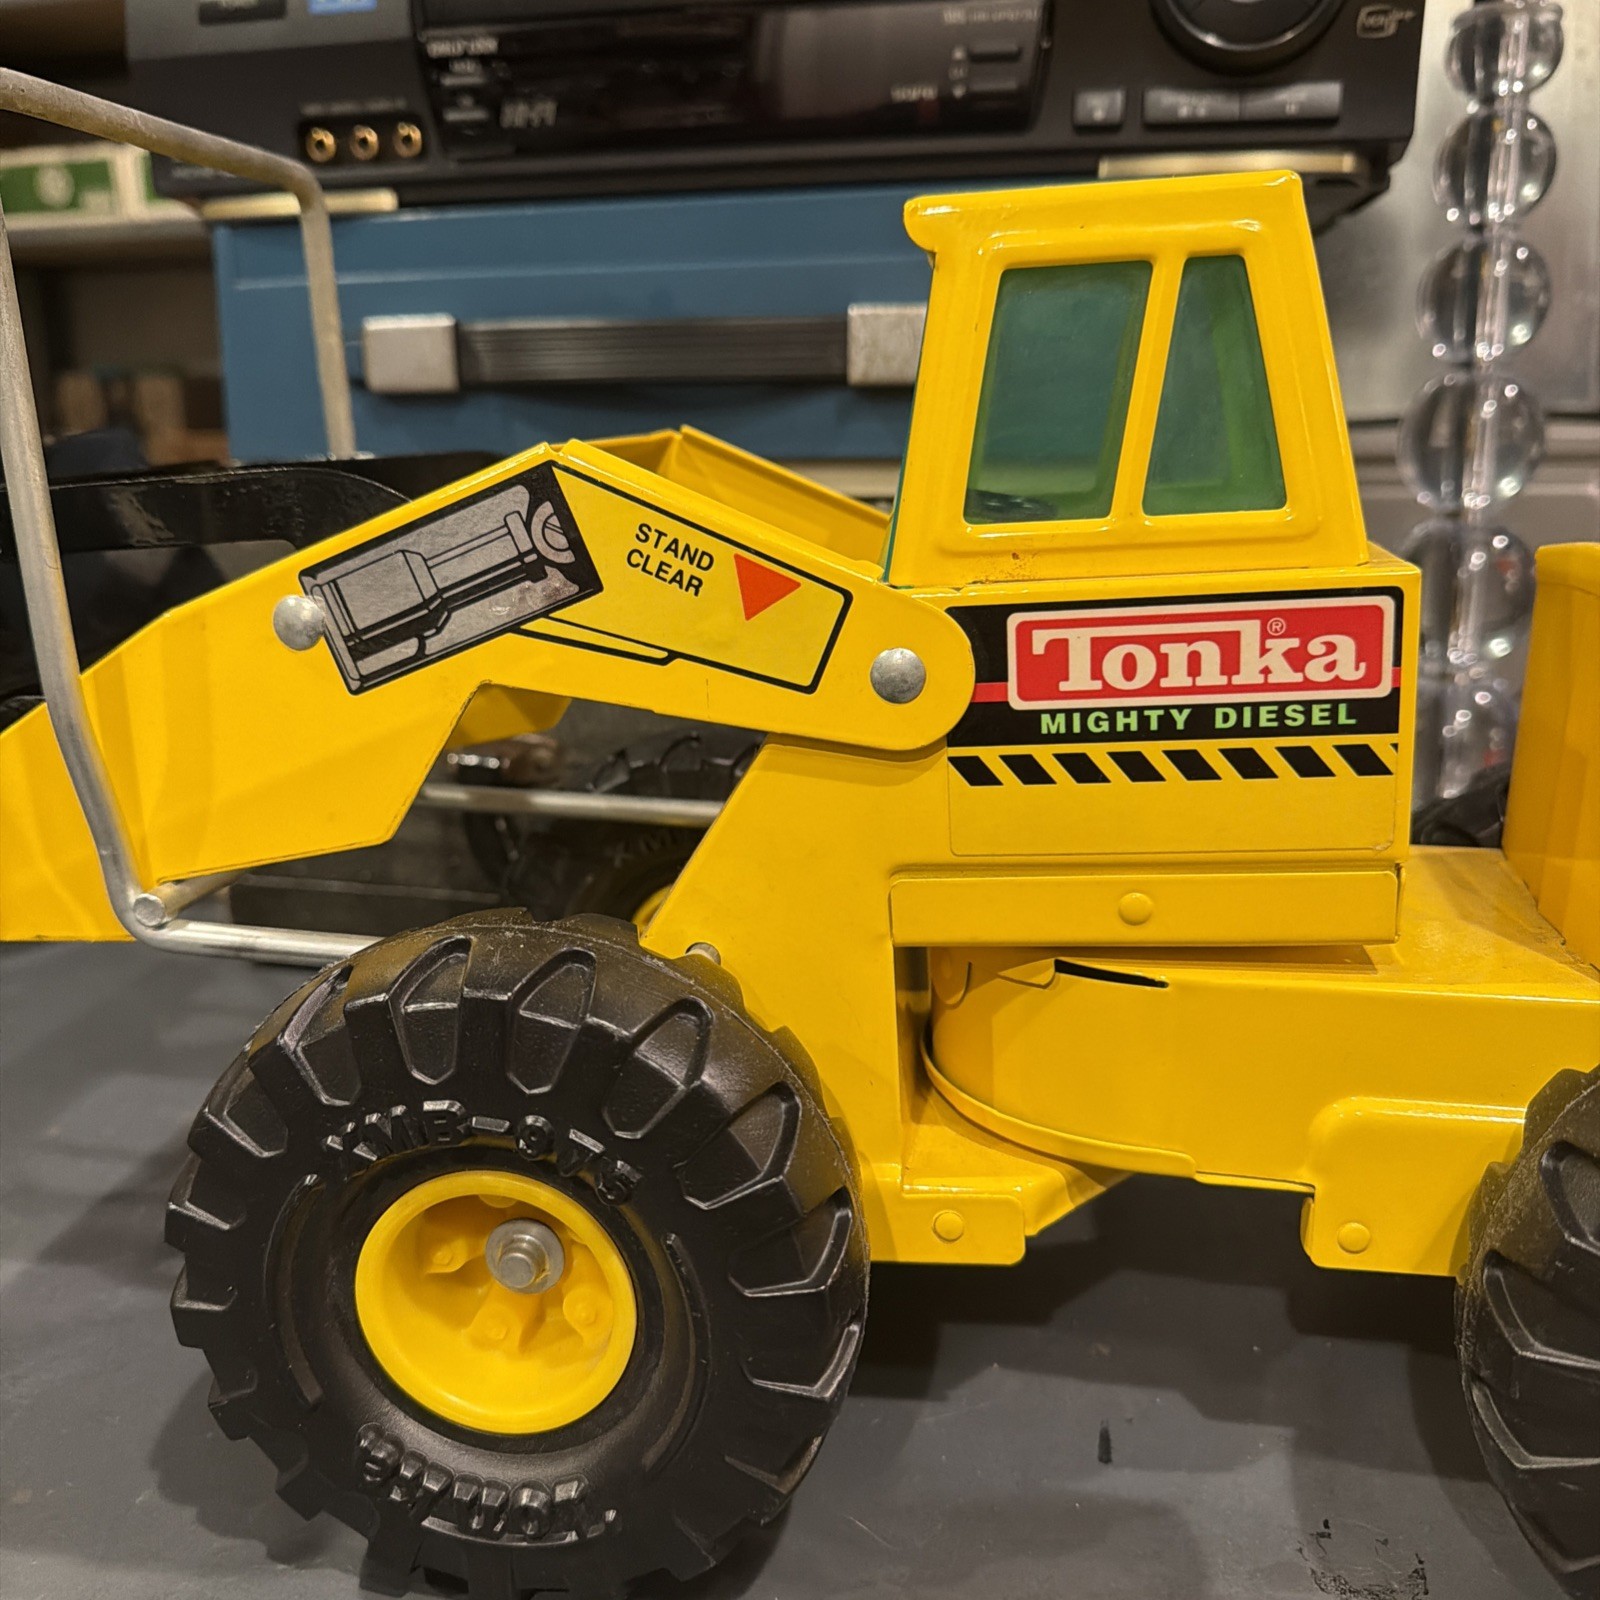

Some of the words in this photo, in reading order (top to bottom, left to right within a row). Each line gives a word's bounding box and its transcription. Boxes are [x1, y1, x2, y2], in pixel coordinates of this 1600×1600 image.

[635, 523, 715, 572] STAND
[626, 548, 704, 597] CLEAR
[1031, 618, 1367, 692] Tonka
[1040, 708, 1192, 735] MIGHTY
[1214, 703, 1358, 729] DIESEL
